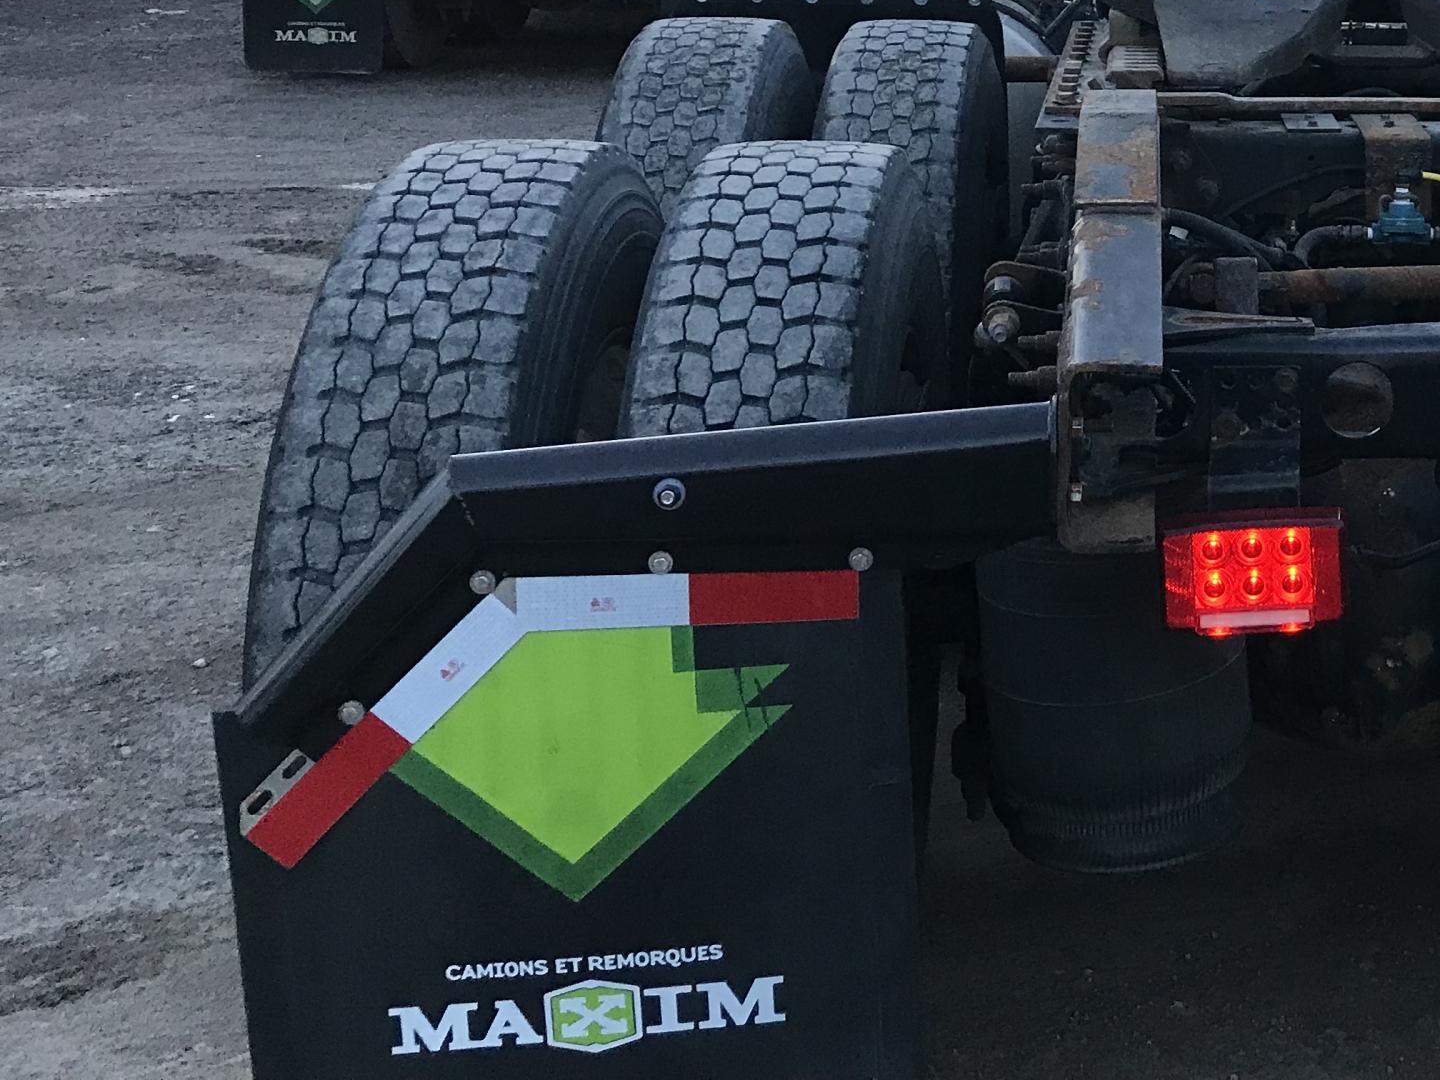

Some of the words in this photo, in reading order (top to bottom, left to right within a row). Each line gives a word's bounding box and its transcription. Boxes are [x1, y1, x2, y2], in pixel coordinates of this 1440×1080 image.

[445, 959, 549, 981] CAMIONS
[555, 957, 583, 974] ET
[587, 944, 724, 971] REMORQUES
[388, 975, 787, 1056] MAXIM
